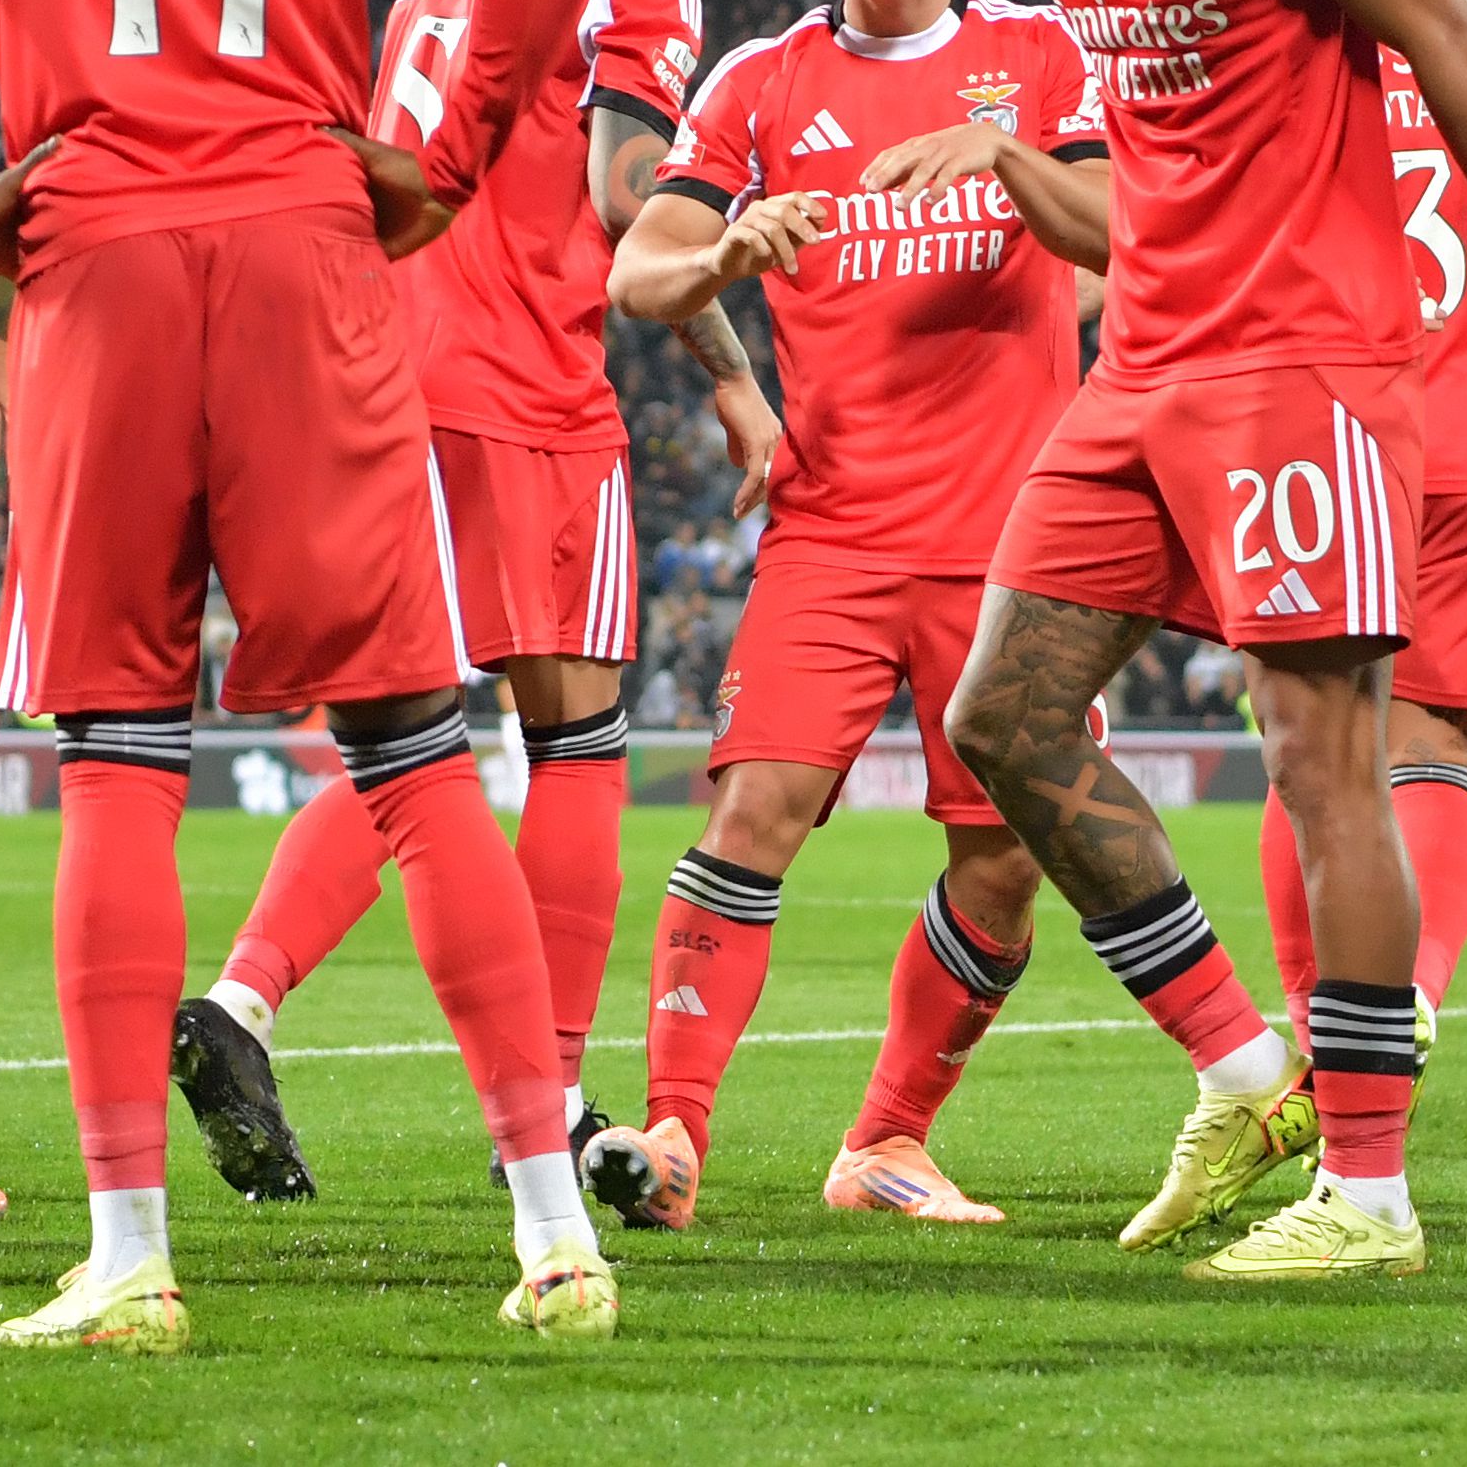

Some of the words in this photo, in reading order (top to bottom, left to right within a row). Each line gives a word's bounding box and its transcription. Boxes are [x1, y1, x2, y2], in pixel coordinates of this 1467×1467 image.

[390, 13, 469, 149] 5
[652, 58, 686, 102] Beta
[1116, 51, 1213, 101] BETTER
[804, 174, 1022, 241] Emirate
[836, 238, 886, 284] FLY
[895, 229, 1005, 277] BETTER
[1225, 459, 1335, 574] 20
